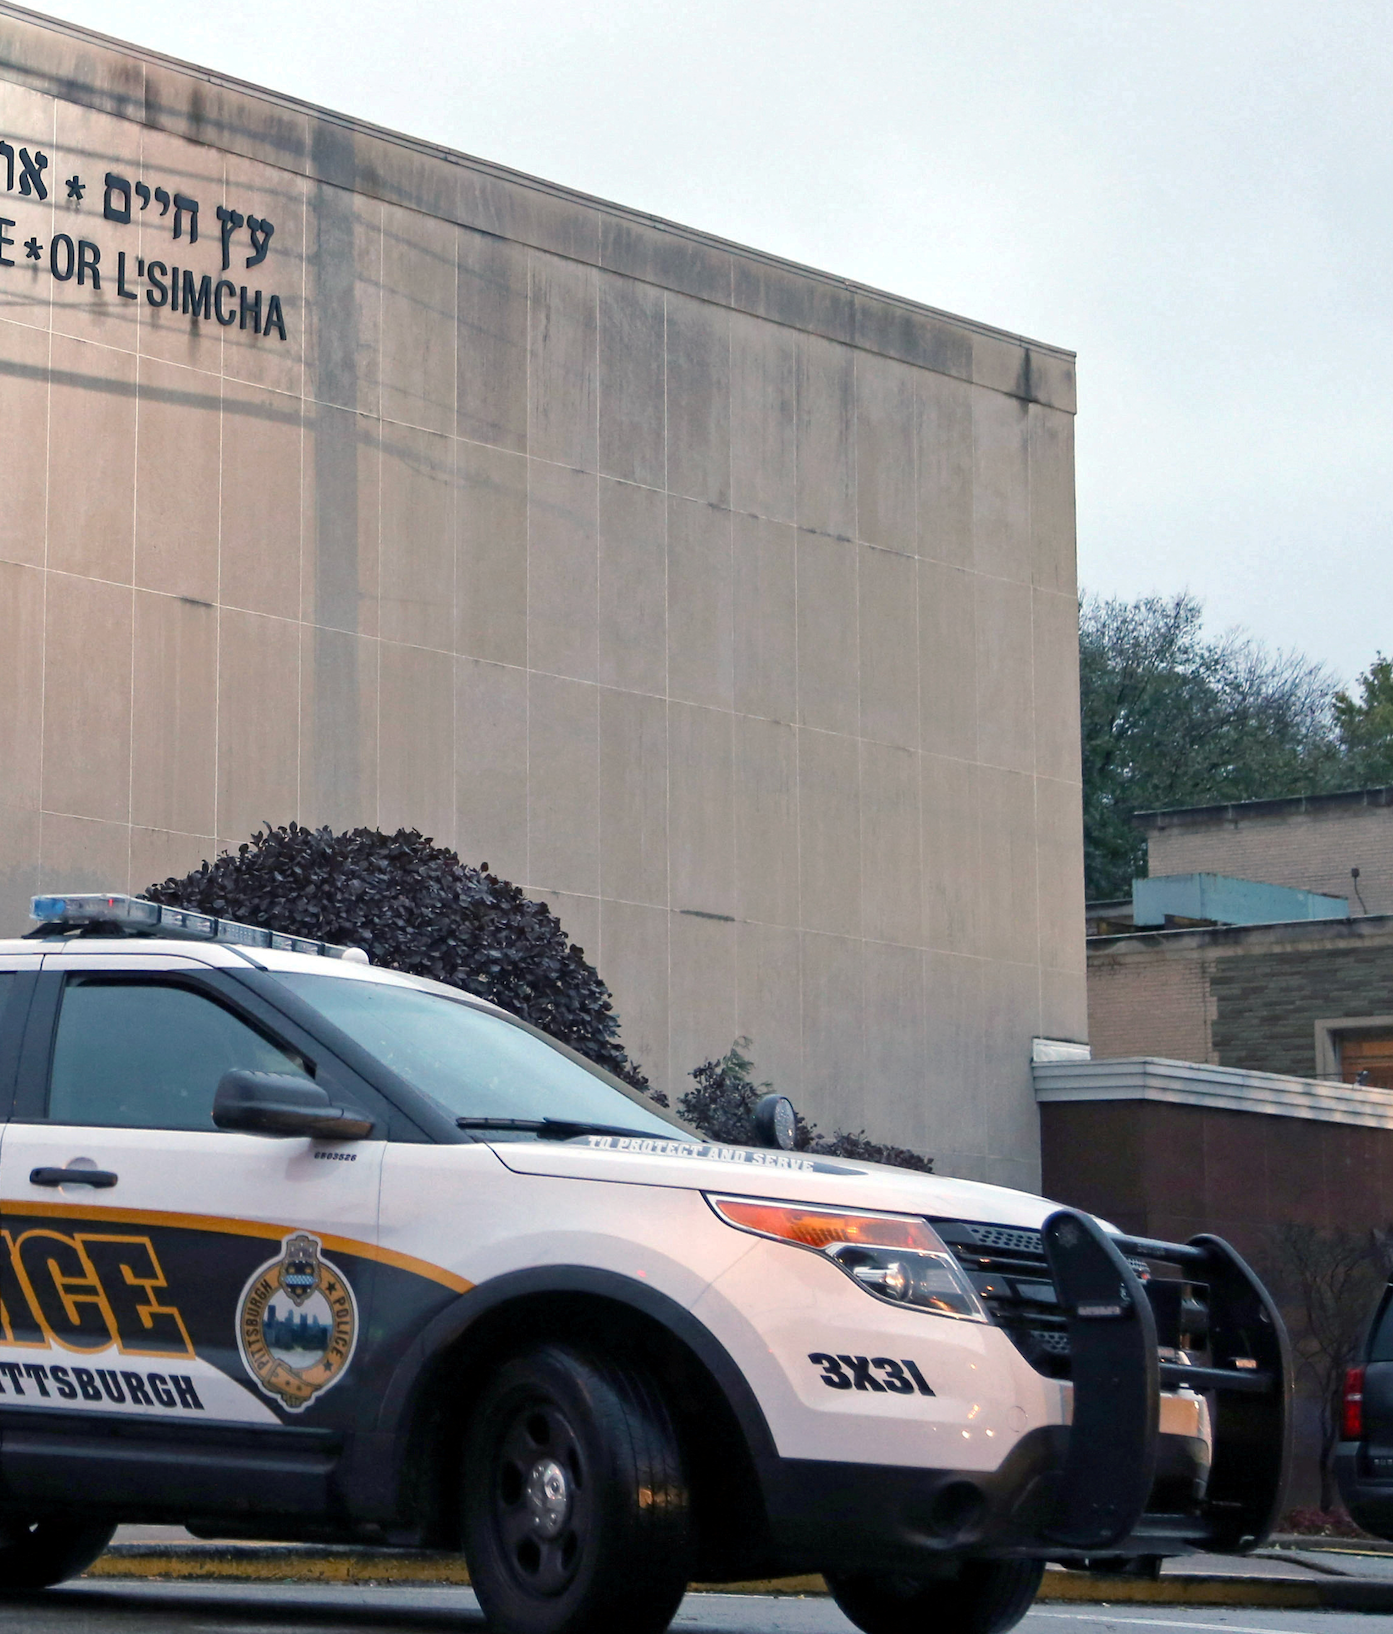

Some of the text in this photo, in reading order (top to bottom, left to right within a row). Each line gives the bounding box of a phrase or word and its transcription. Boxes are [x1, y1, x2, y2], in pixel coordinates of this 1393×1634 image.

[103, 172, 199, 245] חיים
[216, 205, 274, 271] עץ
[50, 234, 101, 290] OR
[118, 252, 287, 341] L'SIMCHA
[588, 1136, 815, 1173] TO PROTECT AND SERVE
[245, 1278, 349, 1371] PITTSBURGH POLICE
